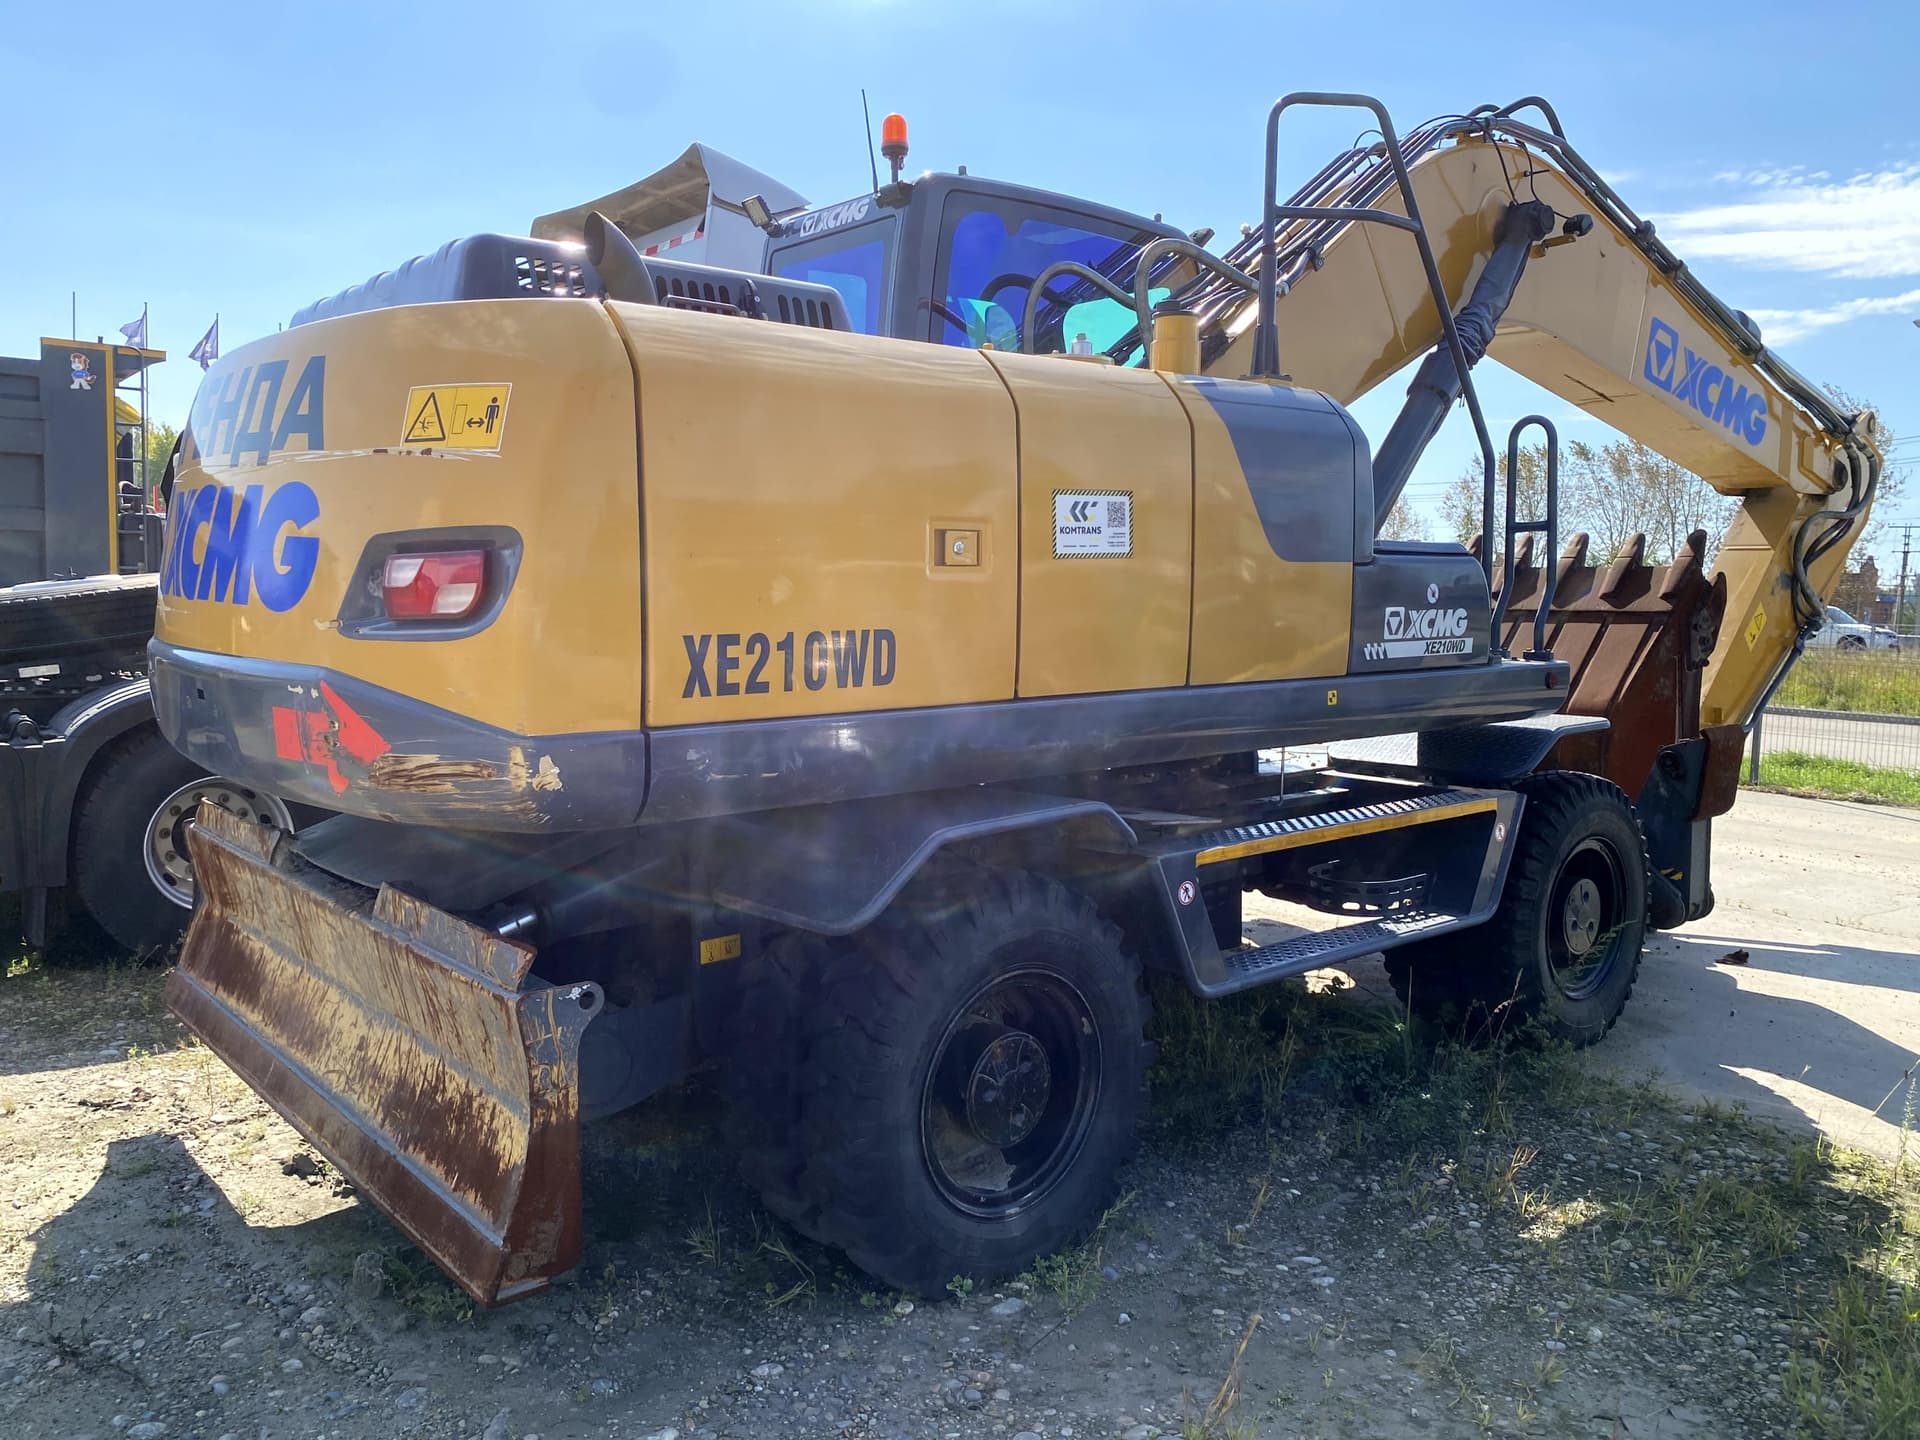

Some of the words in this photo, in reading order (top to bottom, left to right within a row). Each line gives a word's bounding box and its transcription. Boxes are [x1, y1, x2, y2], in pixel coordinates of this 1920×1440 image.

[819, 199, 870, 232] XCMG
[178, 355, 326, 468] ЕНДА
[1671, 346, 1767, 446] XCMG
[163, 481, 321, 613] XCMG
[1059, 526, 1102, 535] KOMTRANS
[1403, 608, 1468, 638] XCMG
[1424, 640, 1466, 655] XE210WD
[682, 628, 896, 698] XE210WD
